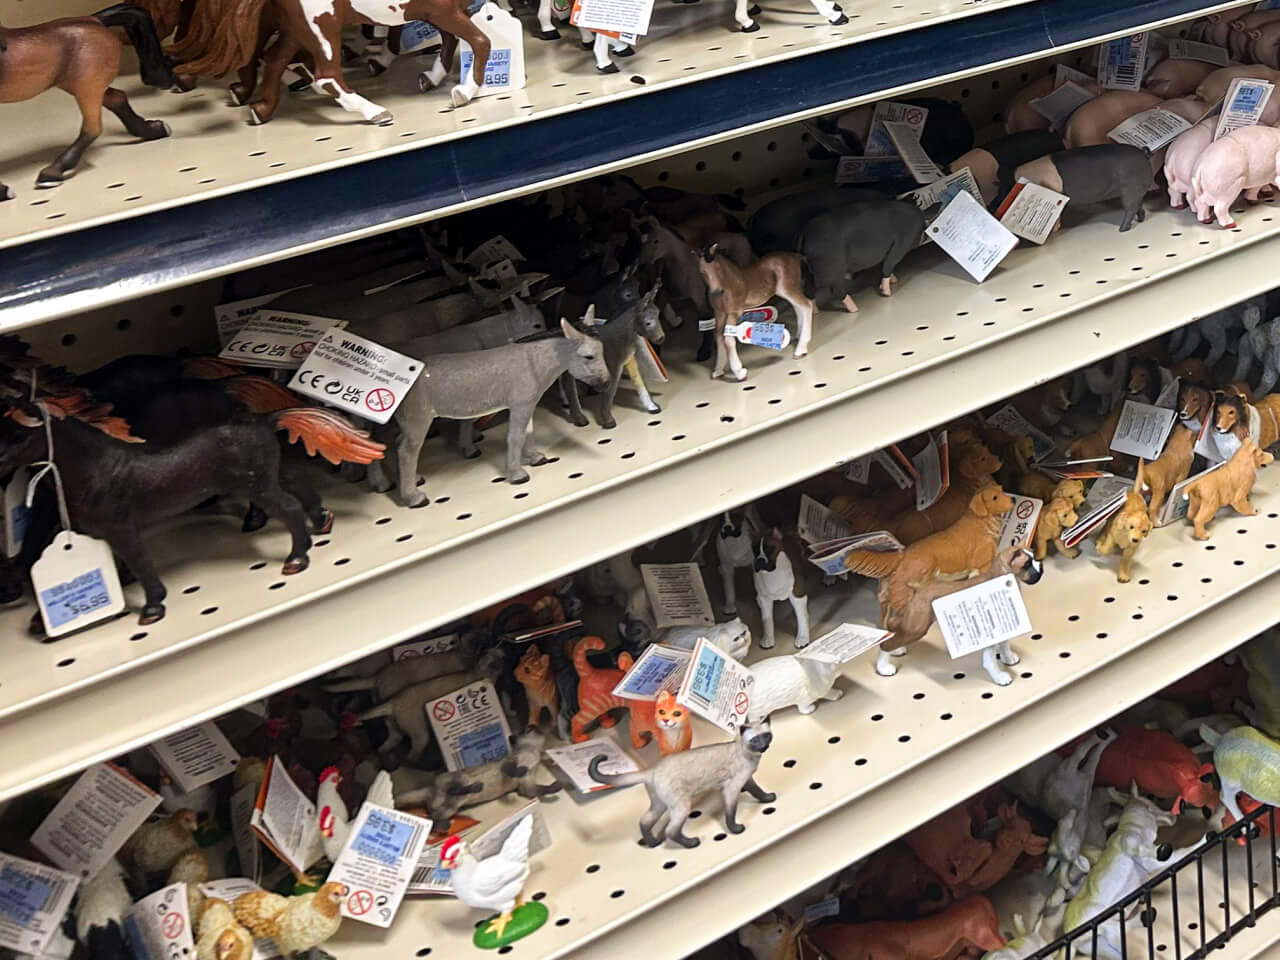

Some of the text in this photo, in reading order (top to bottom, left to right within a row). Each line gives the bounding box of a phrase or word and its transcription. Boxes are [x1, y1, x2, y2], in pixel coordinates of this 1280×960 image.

[318, 342, 348, 360] CHOKING
[349, 354, 377, 370] HAZARD
[379, 368, 396, 379] small
[340, 339, 387, 365] WARNING:
[298, 370, 366, 397] CE UK
